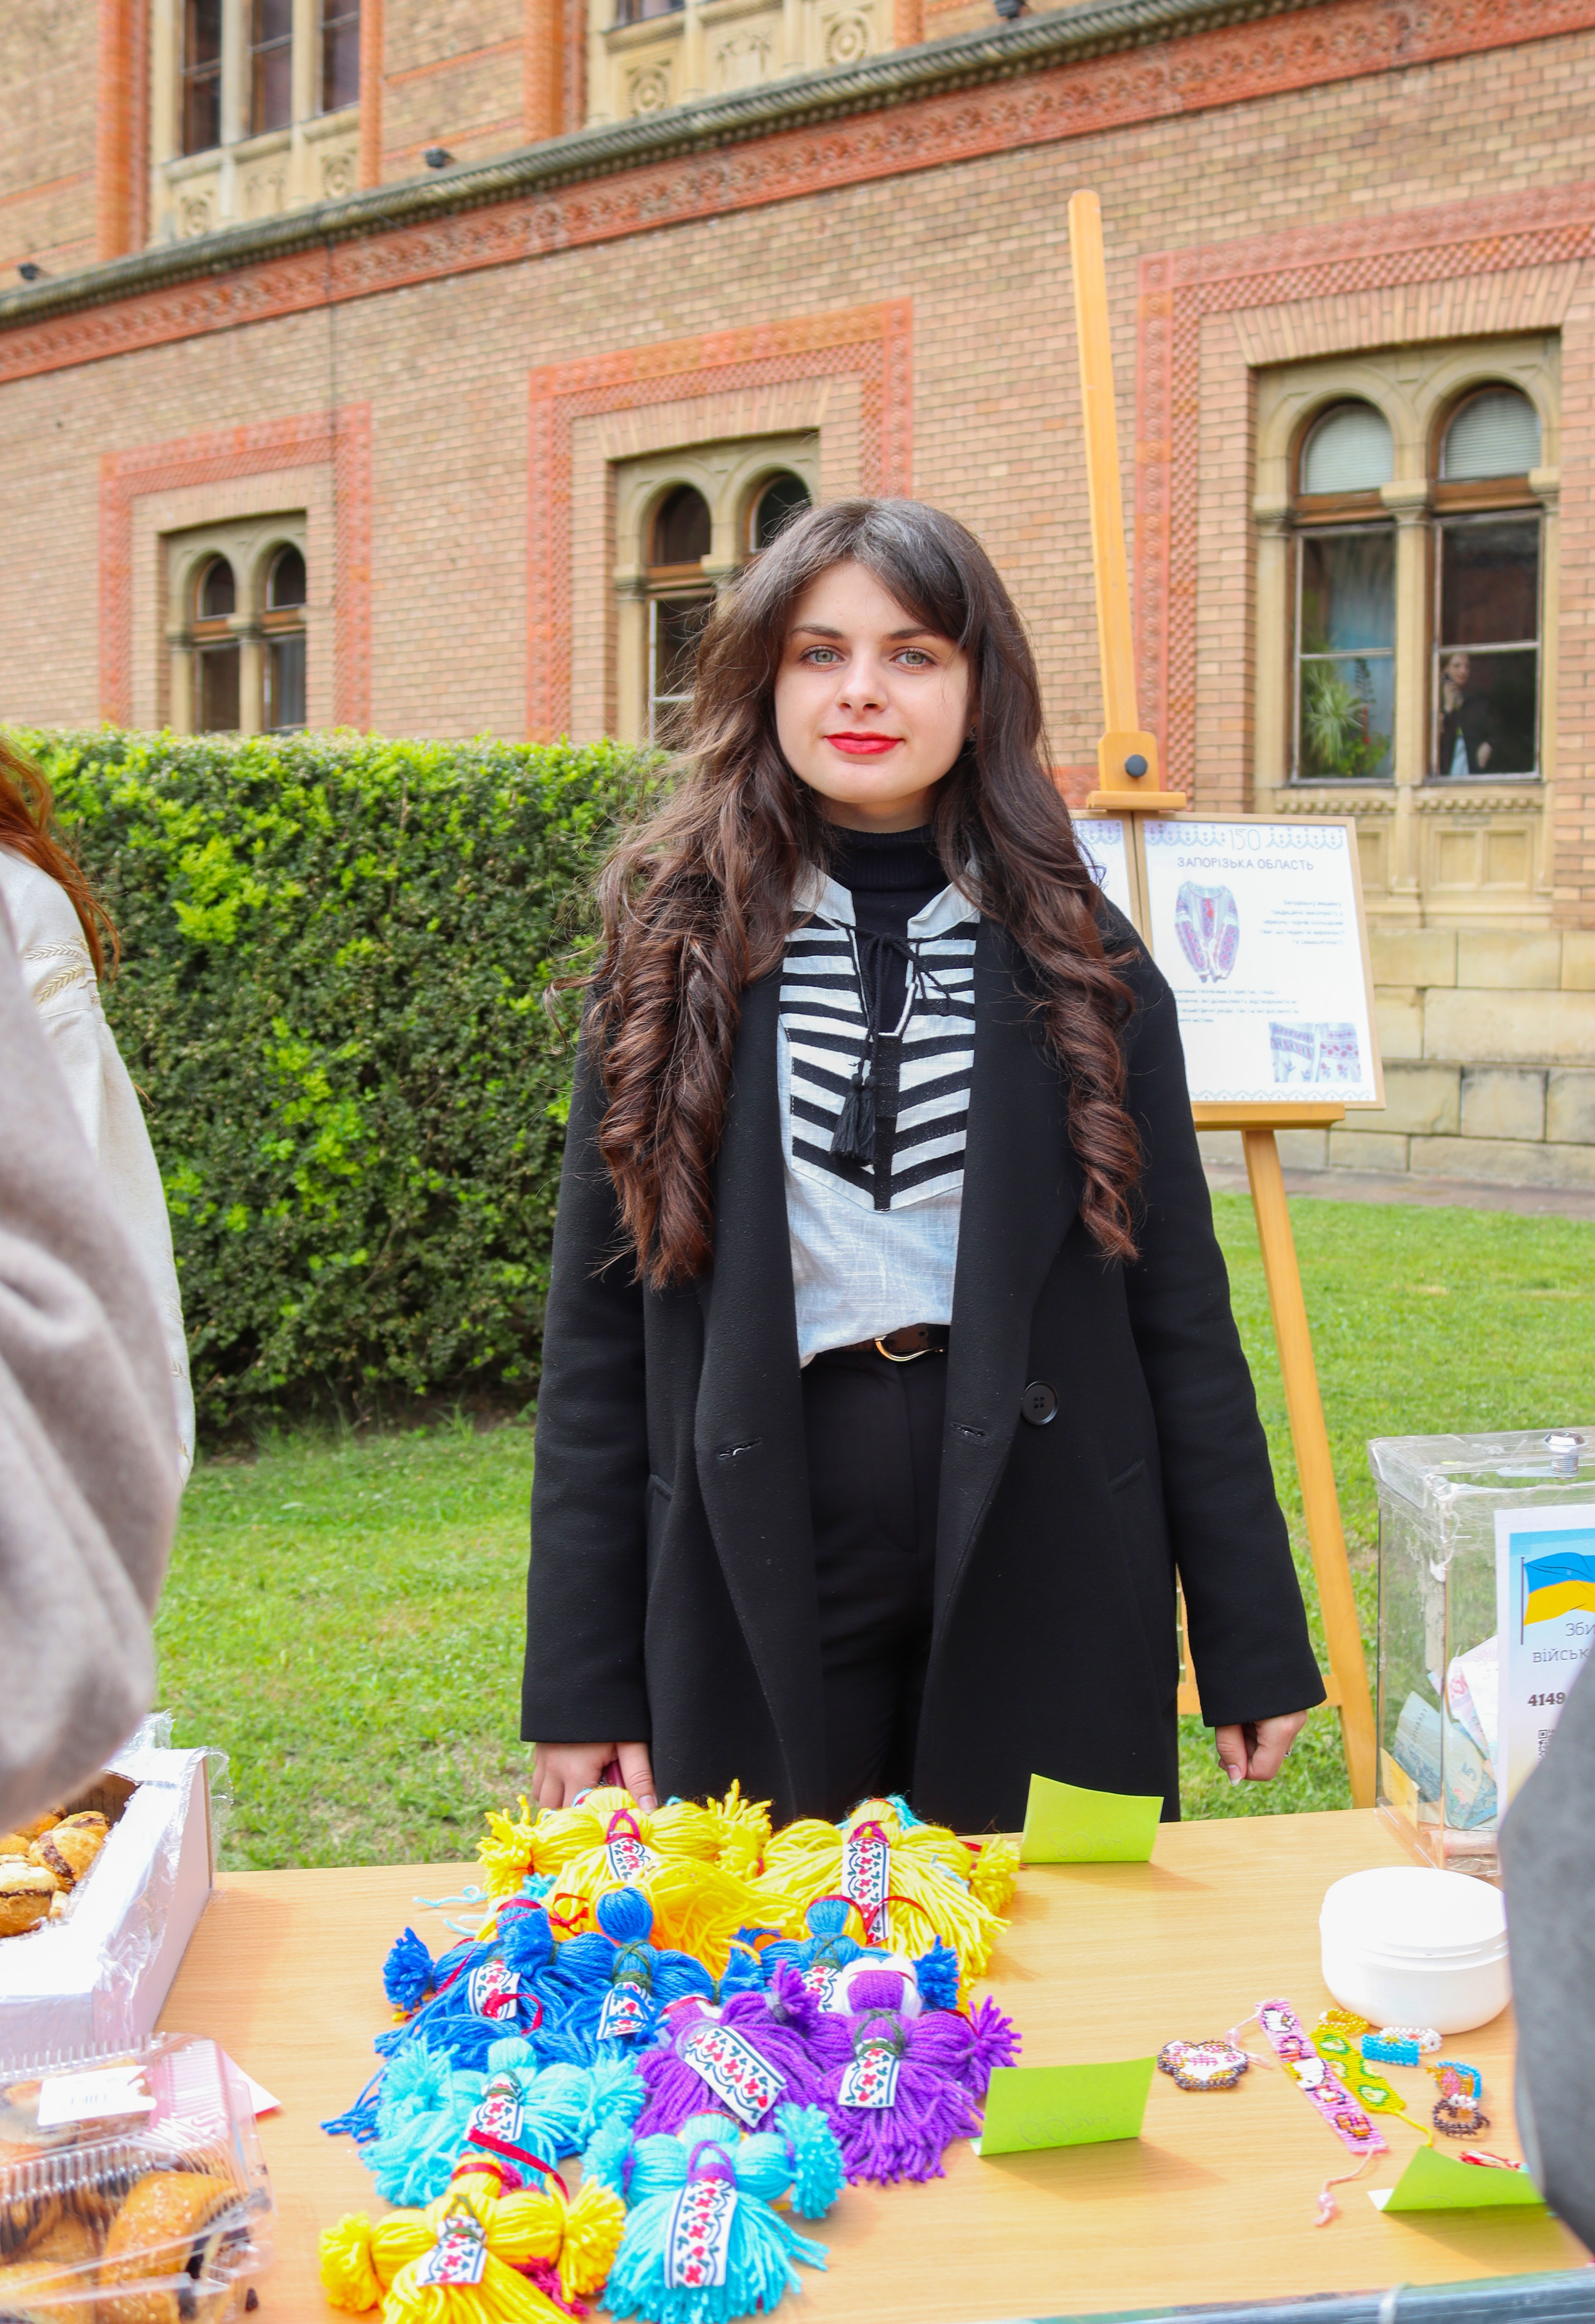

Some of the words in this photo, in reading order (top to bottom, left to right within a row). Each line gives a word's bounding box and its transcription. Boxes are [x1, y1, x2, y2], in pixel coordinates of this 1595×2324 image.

[1229, 828, 1261, 851] 150
[1177, 856, 1254, 869] ЗАПОРІЗЬКА
[1257, 858, 1314, 870] ОБЛАСТЬ
[1527, 1692, 1566, 1706] 4149
